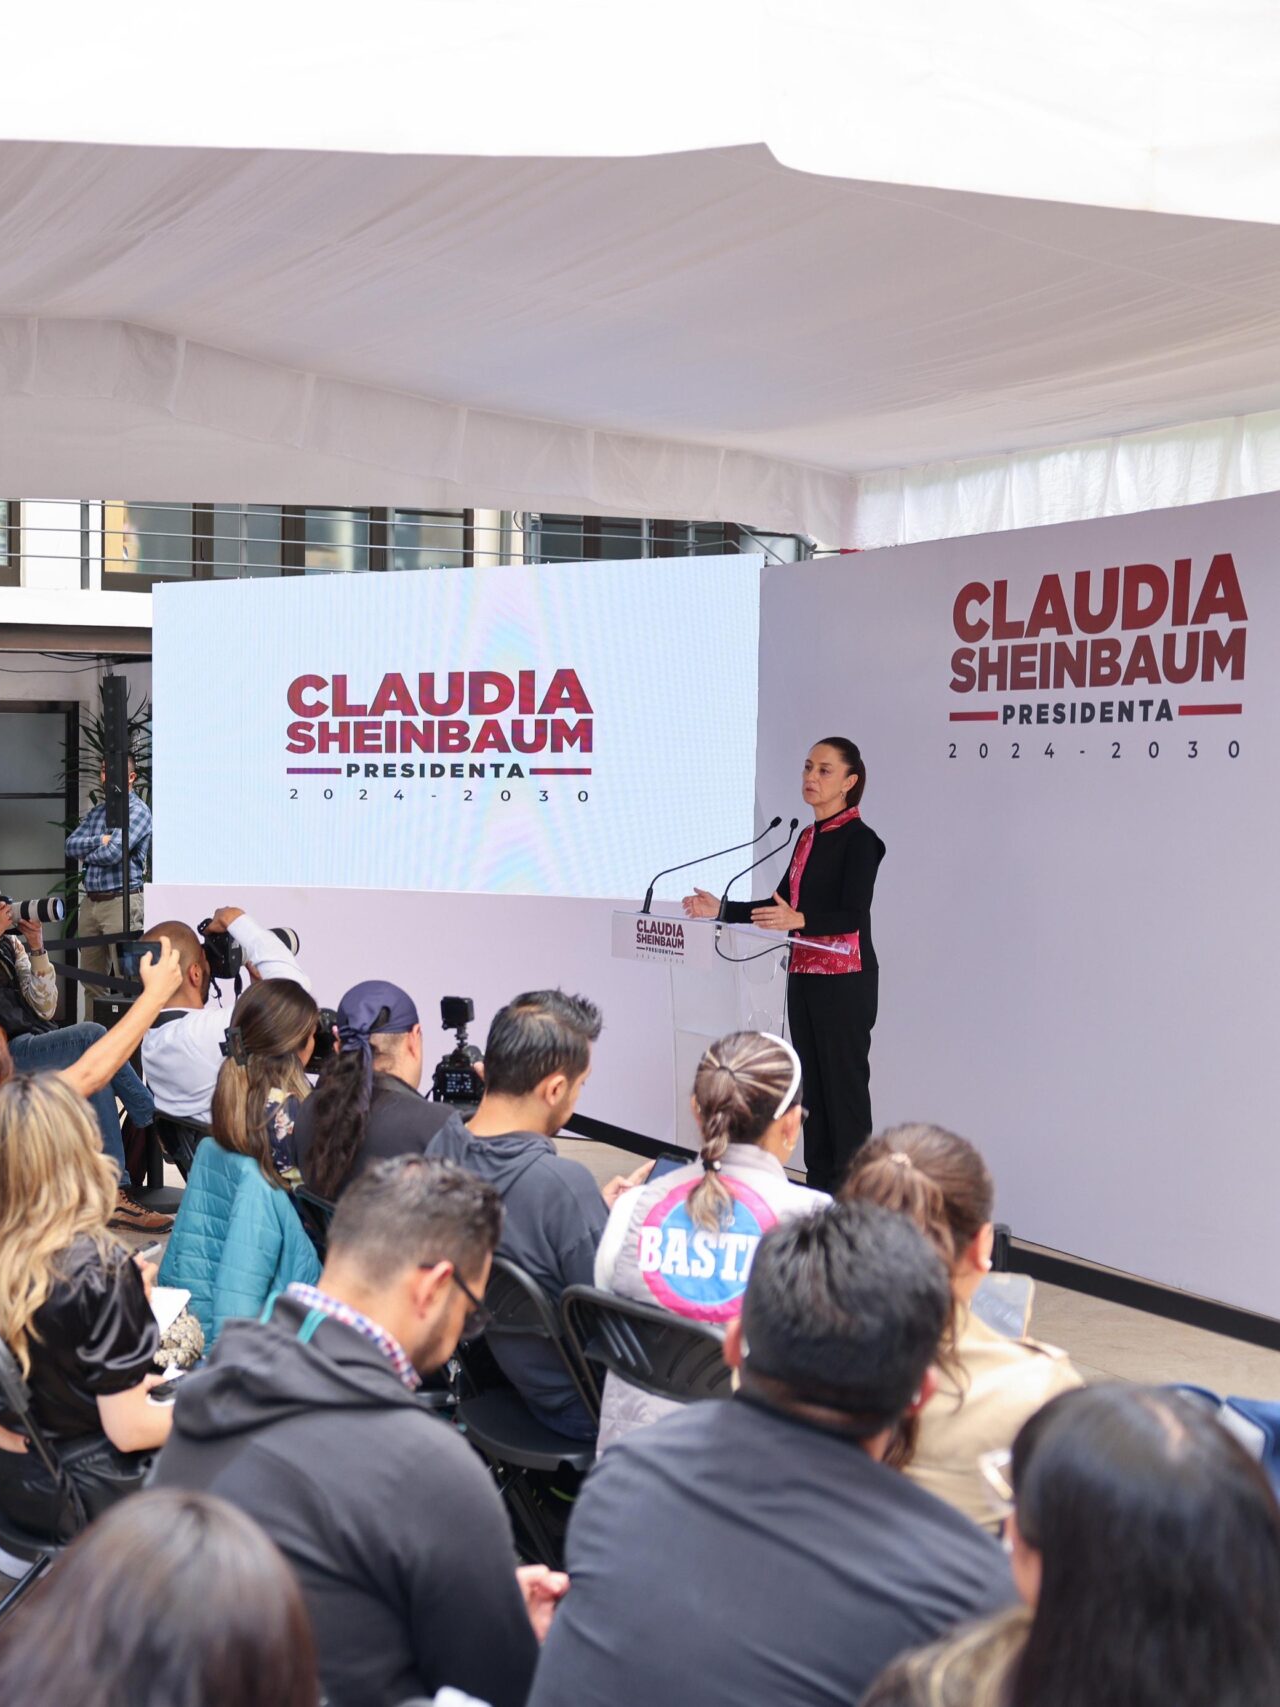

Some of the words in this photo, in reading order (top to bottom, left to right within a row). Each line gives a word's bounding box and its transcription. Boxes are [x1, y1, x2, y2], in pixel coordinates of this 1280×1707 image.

[952, 552, 1248, 643] CLAUDIA
[949, 627, 1247, 694] SHEINBAUM
[286, 668, 594, 718] CLAUDIA
[1002, 699, 1174, 725] PRESIDENTA
[285, 718, 593, 754] SHEINBAUM
[346, 763, 525, 778] PRESIDENTA
[636, 919, 685, 938] CLAUDIA
[636, 933, 685, 949] SHEINBAUM
